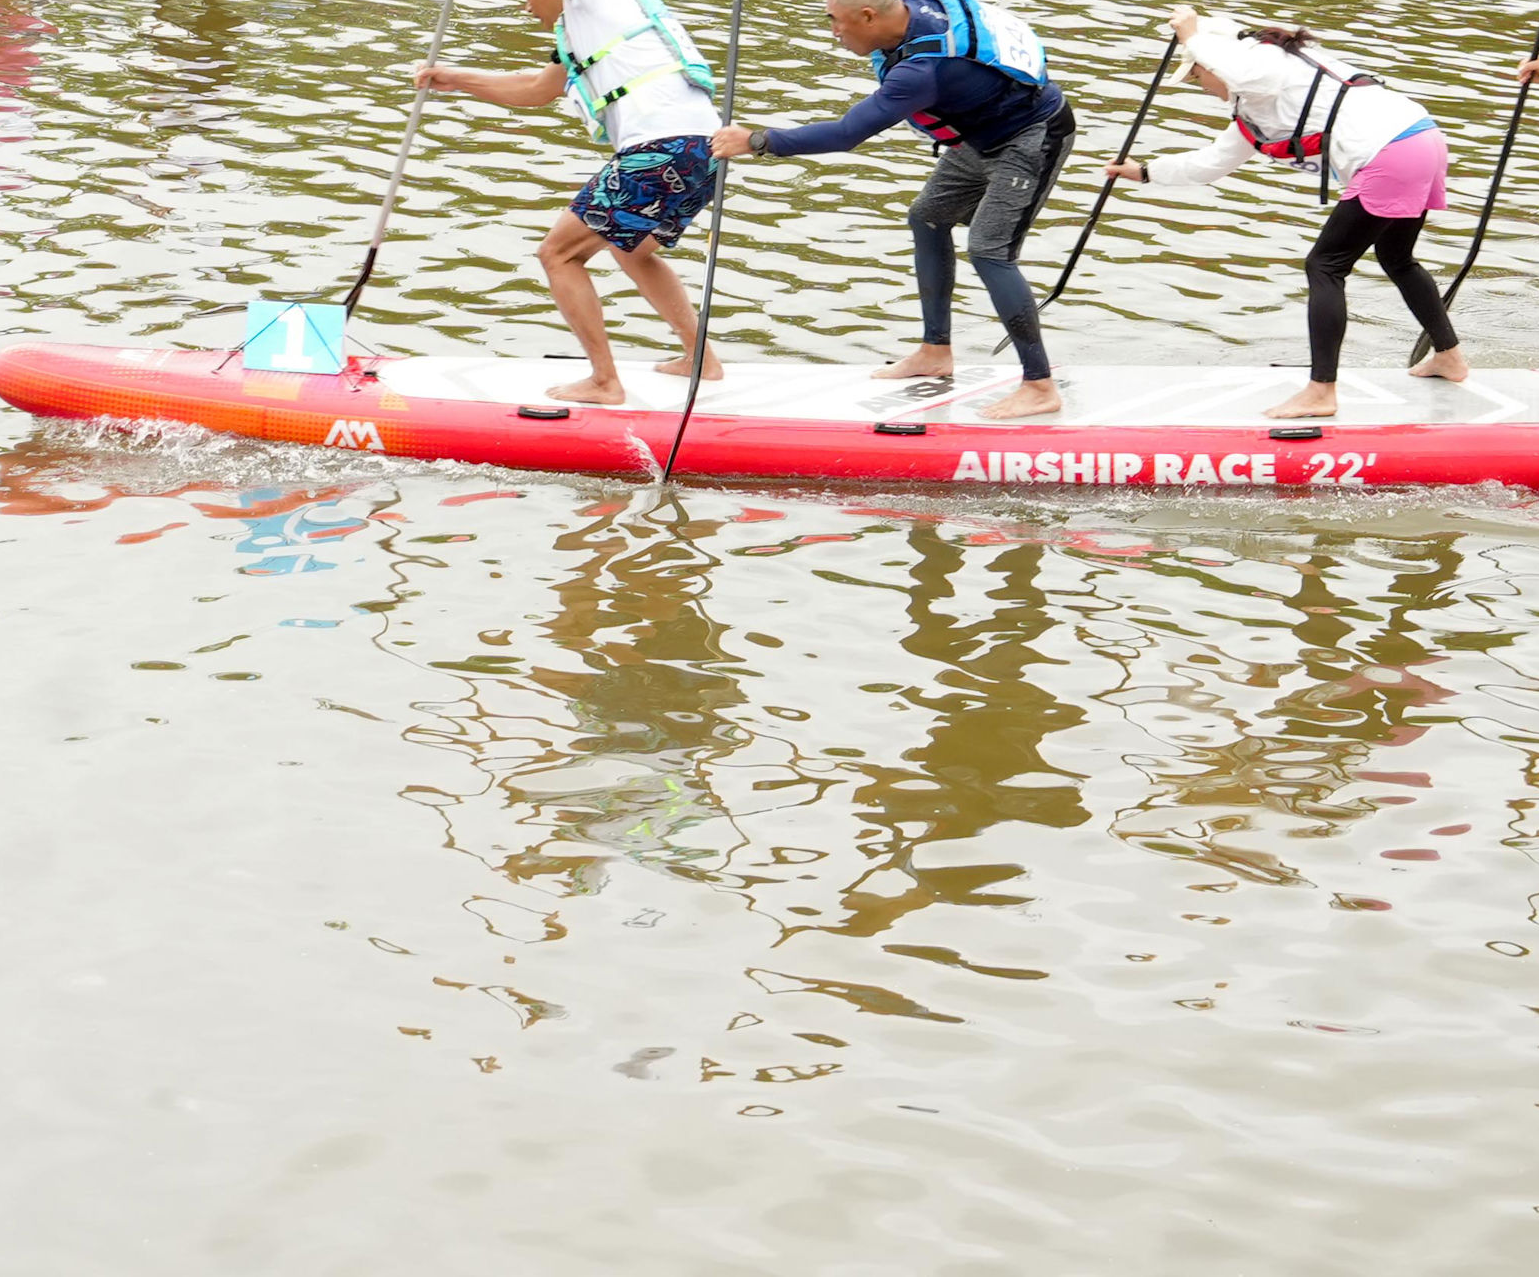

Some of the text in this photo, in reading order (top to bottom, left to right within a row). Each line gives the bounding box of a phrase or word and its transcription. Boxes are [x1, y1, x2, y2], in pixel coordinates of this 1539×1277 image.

[271, 303, 313, 370] 1
[953, 450, 1378, 484] AIRSHIP RACE 22'
